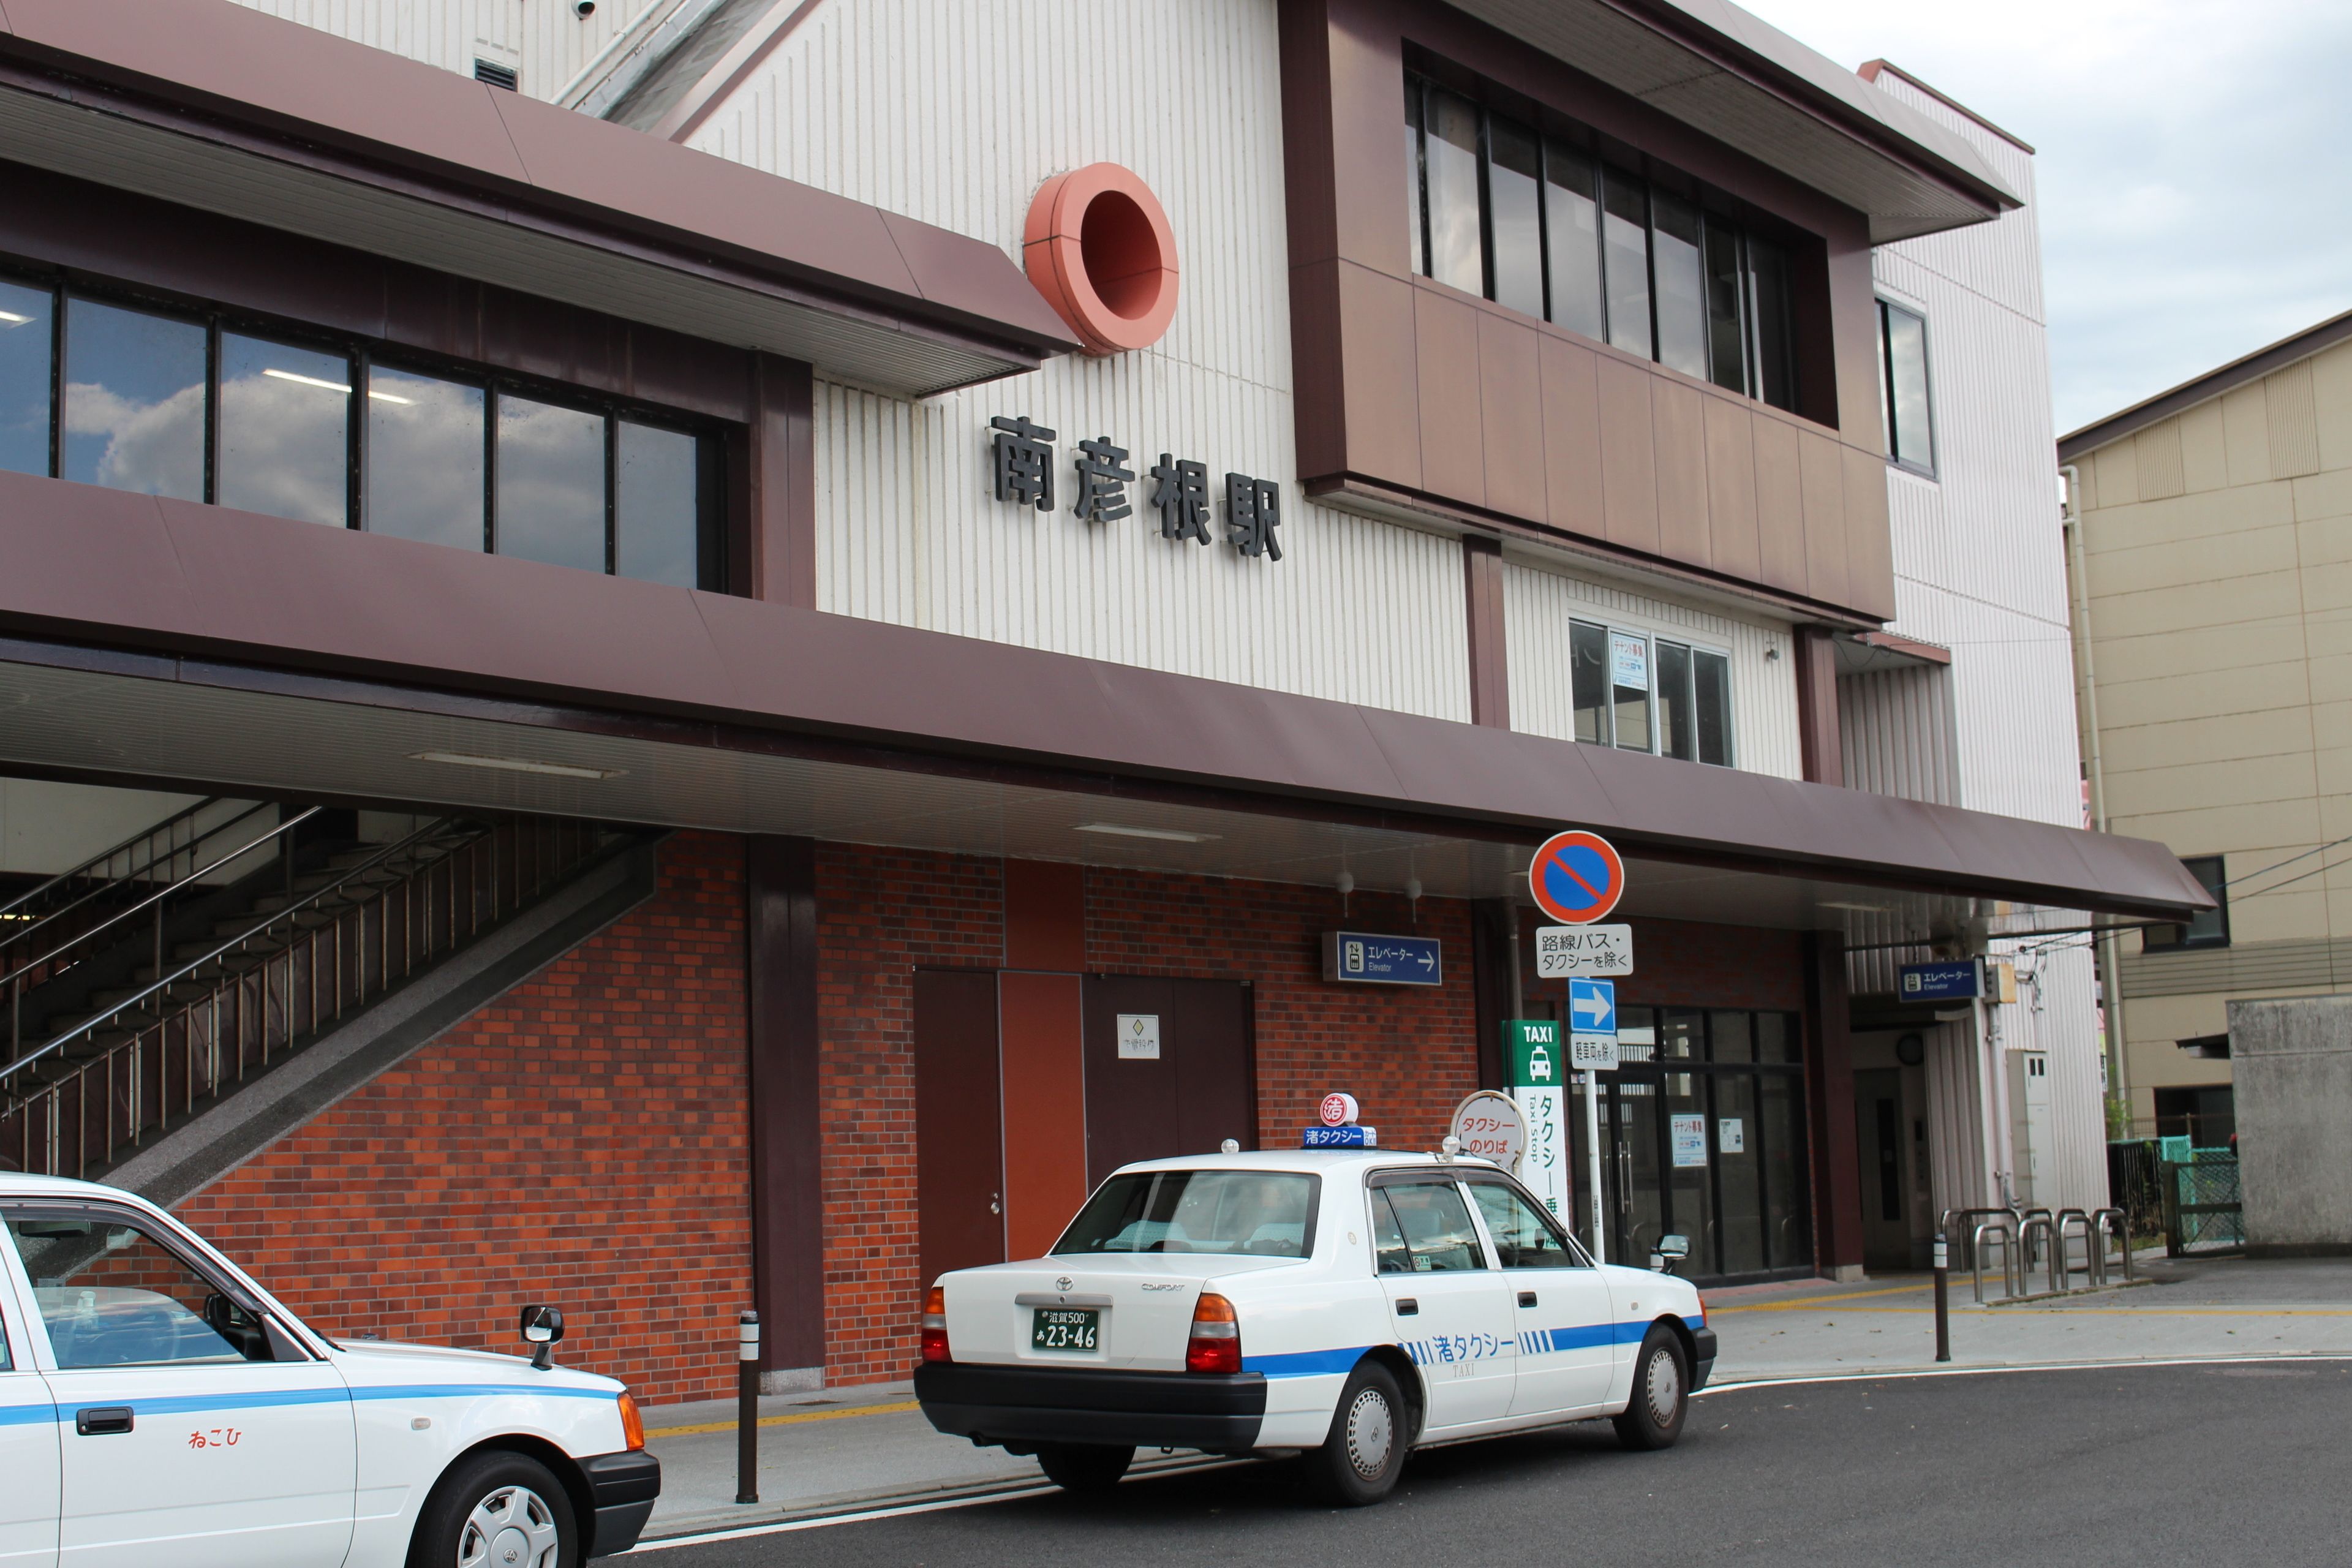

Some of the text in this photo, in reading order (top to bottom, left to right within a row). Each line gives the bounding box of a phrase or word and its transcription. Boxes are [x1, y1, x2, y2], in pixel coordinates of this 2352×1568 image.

[991, 416, 1282, 562] 南彦根駅
[1368, 946, 1414, 961] エレベーター
[1542, 951, 1627, 970] タクシーを除く
[1368, 962, 1392, 972] Elevator
[1924, 971, 1970, 982] エレベーター
[1524, 1025, 1553, 1042] TAXI
[1576, 1042, 1615, 1061] 軽車両を除く
[1463, 1118, 1515, 1132] タクシー
[1306, 1130, 1362, 1144] 渚タクシー
[1470, 1140, 1508, 1154] のりば
[1036, 1325, 1095, 1348] あ 23-46
[1432, 1332, 1514, 1363] 渚タクシー
[1453, 1363, 1475, 1378] TAXI
